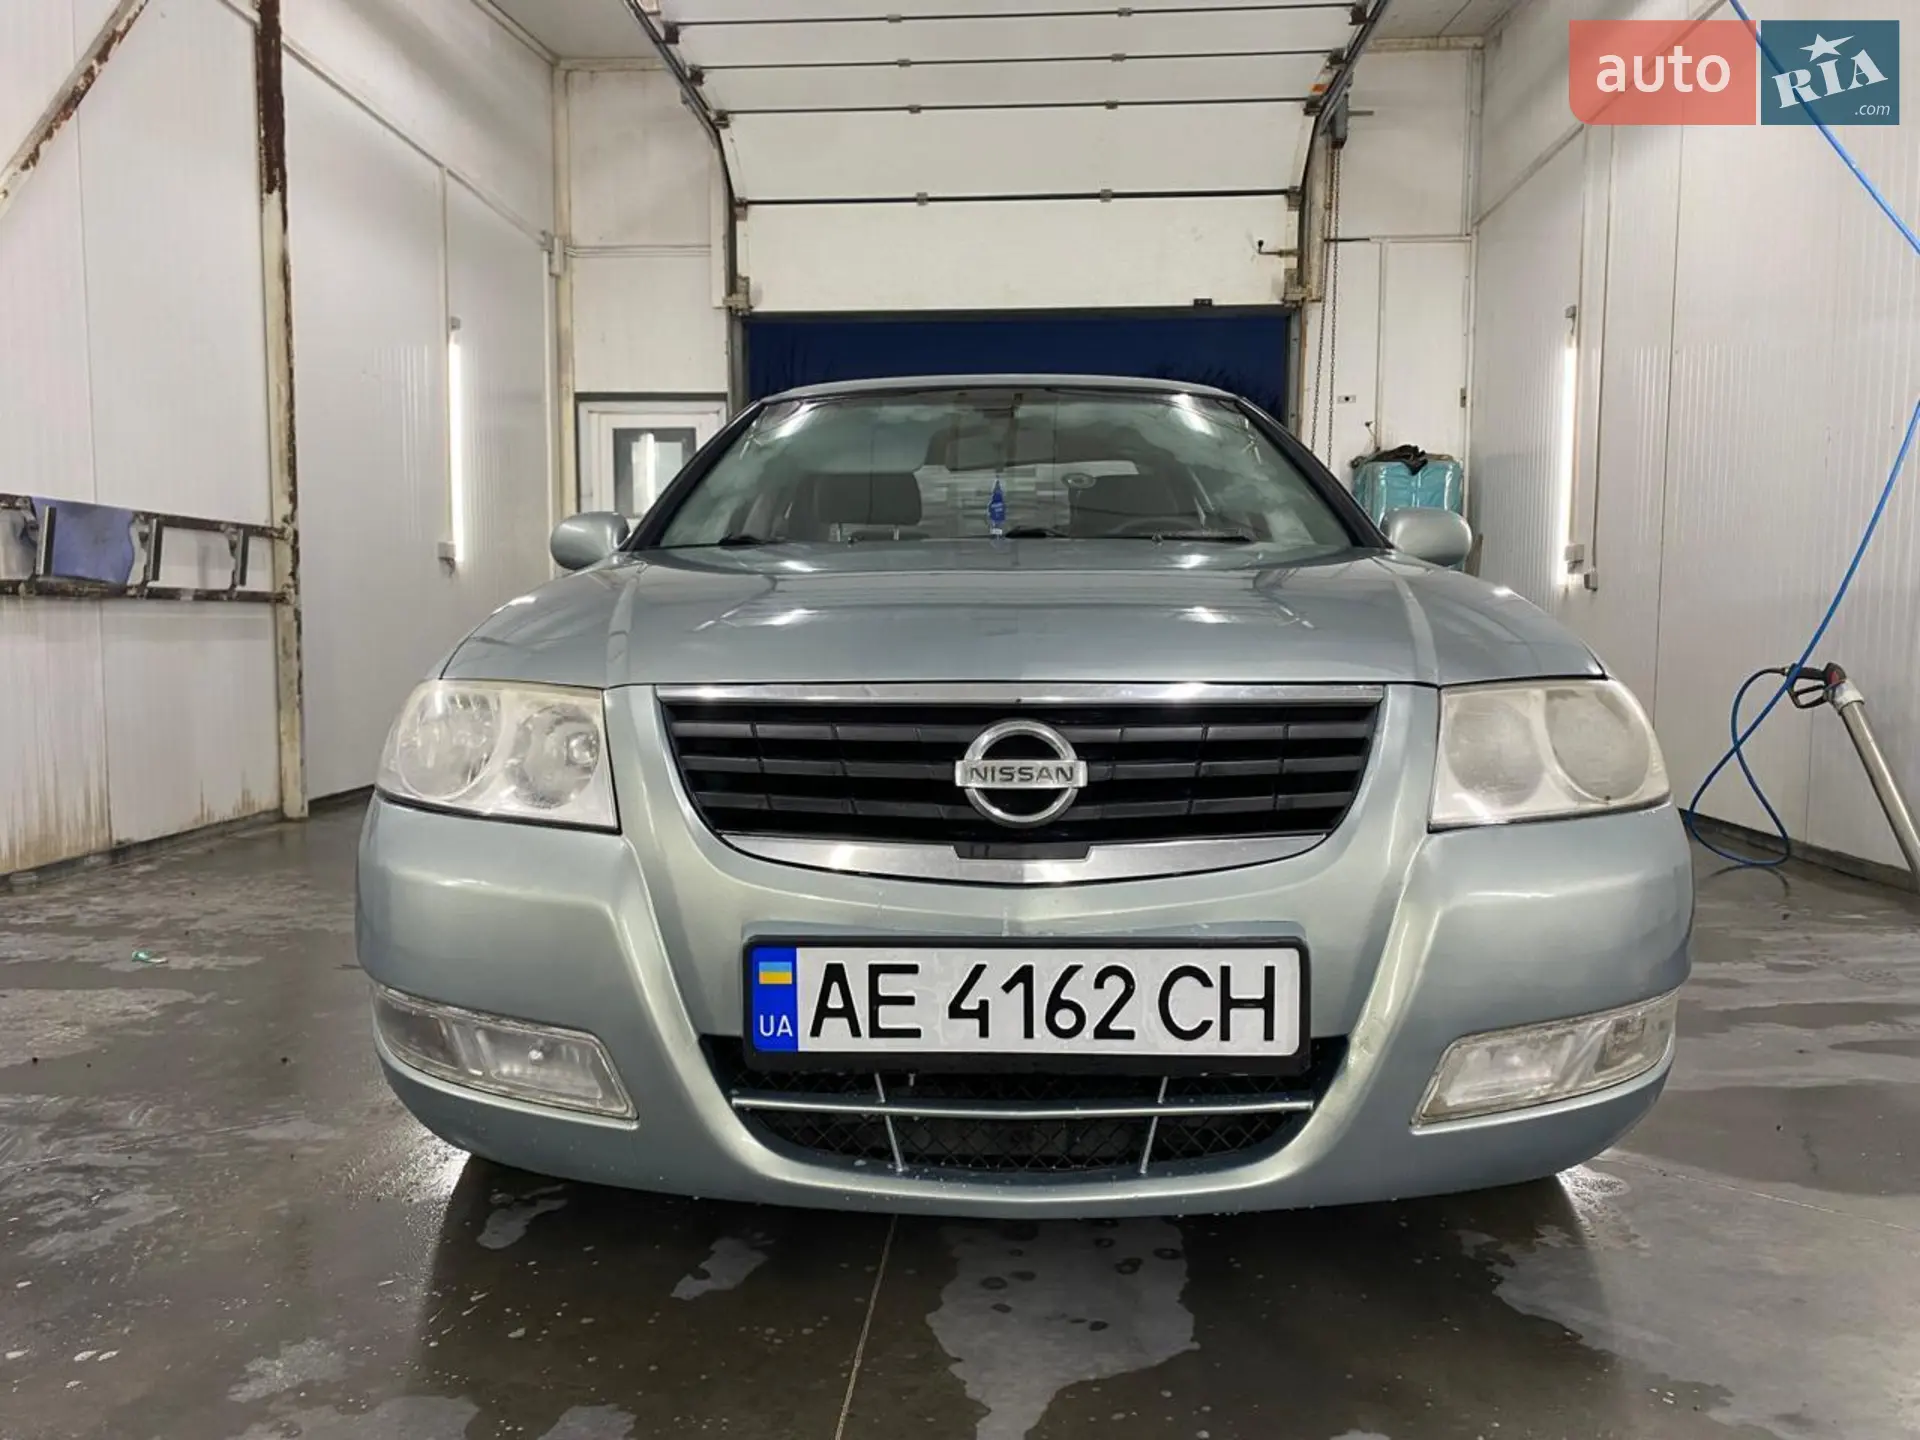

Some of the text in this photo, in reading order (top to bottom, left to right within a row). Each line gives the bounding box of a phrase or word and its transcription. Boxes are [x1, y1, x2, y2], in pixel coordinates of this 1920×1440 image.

[969, 766, 1074, 783] NISSAN
[809, 963, 1276, 1042] AE 4162 CH
[759, 1016, 793, 1038] UA
